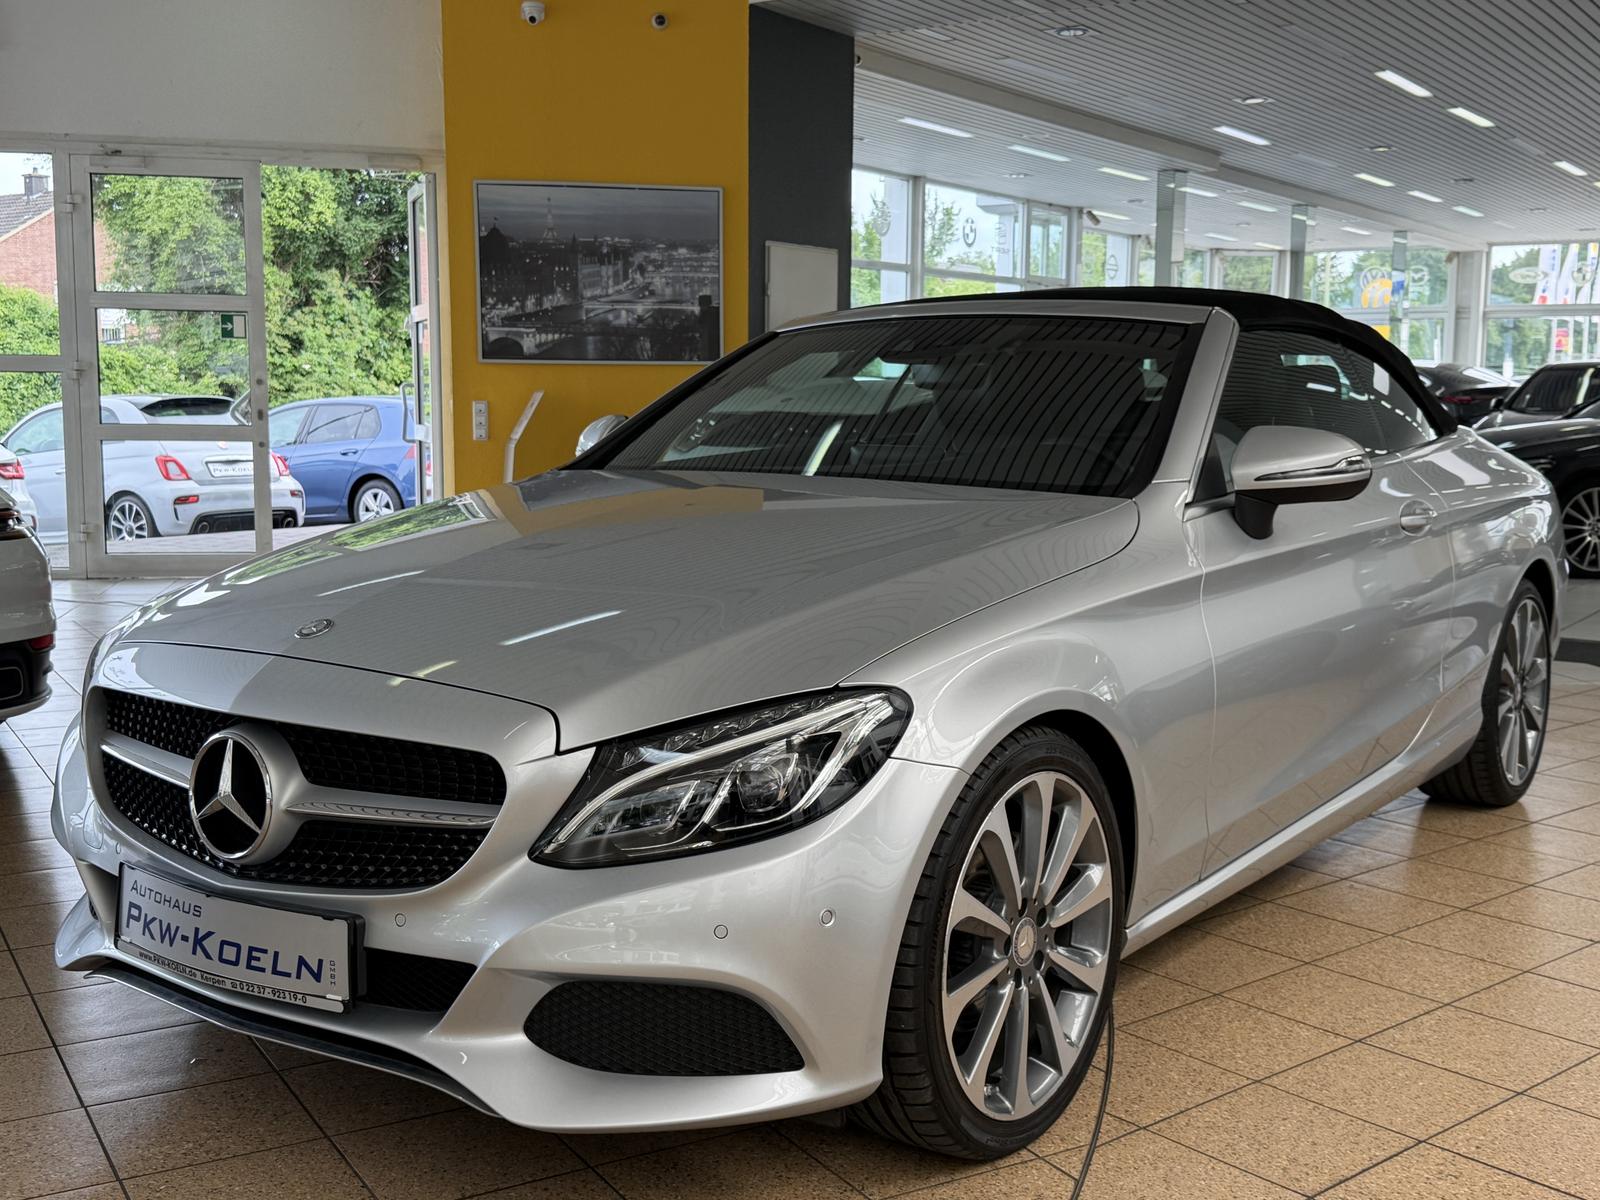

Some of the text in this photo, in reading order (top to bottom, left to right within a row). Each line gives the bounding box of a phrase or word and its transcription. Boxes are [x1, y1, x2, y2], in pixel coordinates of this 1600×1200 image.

[130, 879, 203, 919] AUTOHAUS
[138, 949, 198, 979] www.PKW-KOELN.de
[200, 971, 227, 988] Kerpen
